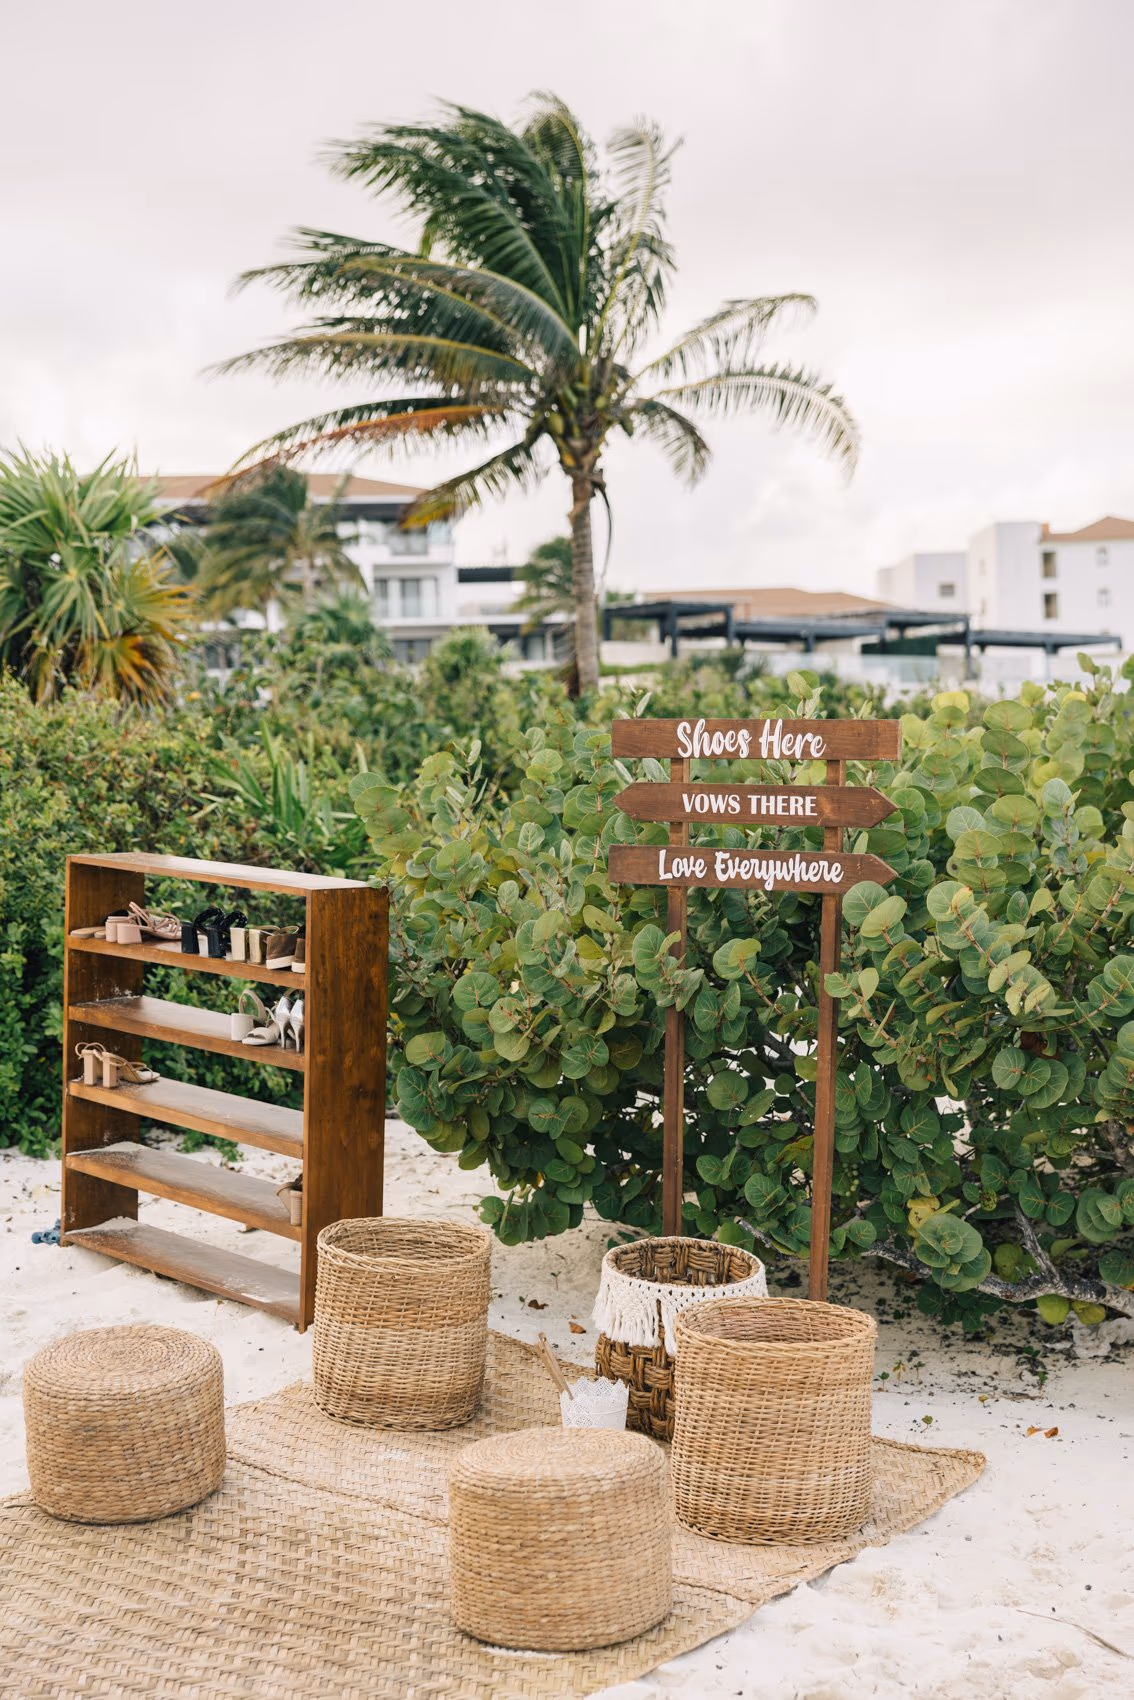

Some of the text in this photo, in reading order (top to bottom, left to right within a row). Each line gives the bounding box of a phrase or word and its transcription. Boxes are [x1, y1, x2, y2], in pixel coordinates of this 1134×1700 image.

[677, 718, 826, 759] Shoes Here
[682, 793, 818, 816] VOWS THERE
[658, 849, 844, 891] Love Everywhere
